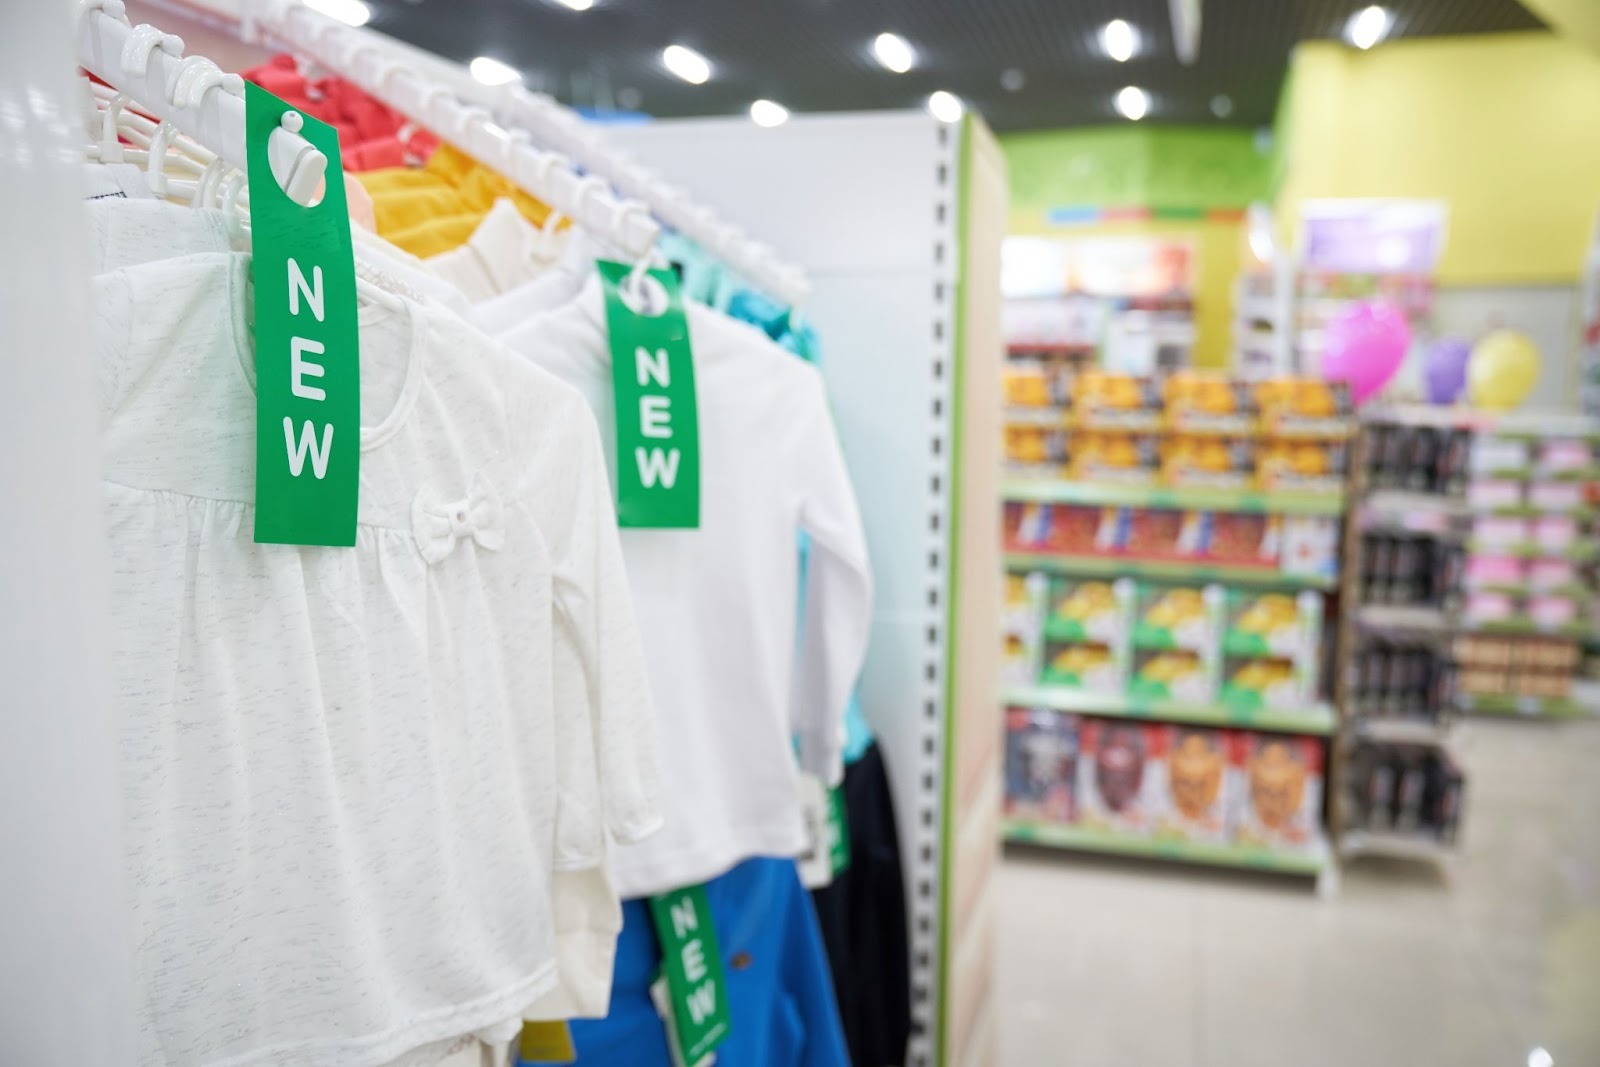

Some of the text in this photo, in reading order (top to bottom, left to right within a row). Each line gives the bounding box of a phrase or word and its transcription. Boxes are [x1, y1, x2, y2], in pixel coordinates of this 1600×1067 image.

[283, 257, 335, 480] NEW
[633, 346, 681, 490] NEW
[670, 896, 717, 1026] NEW
